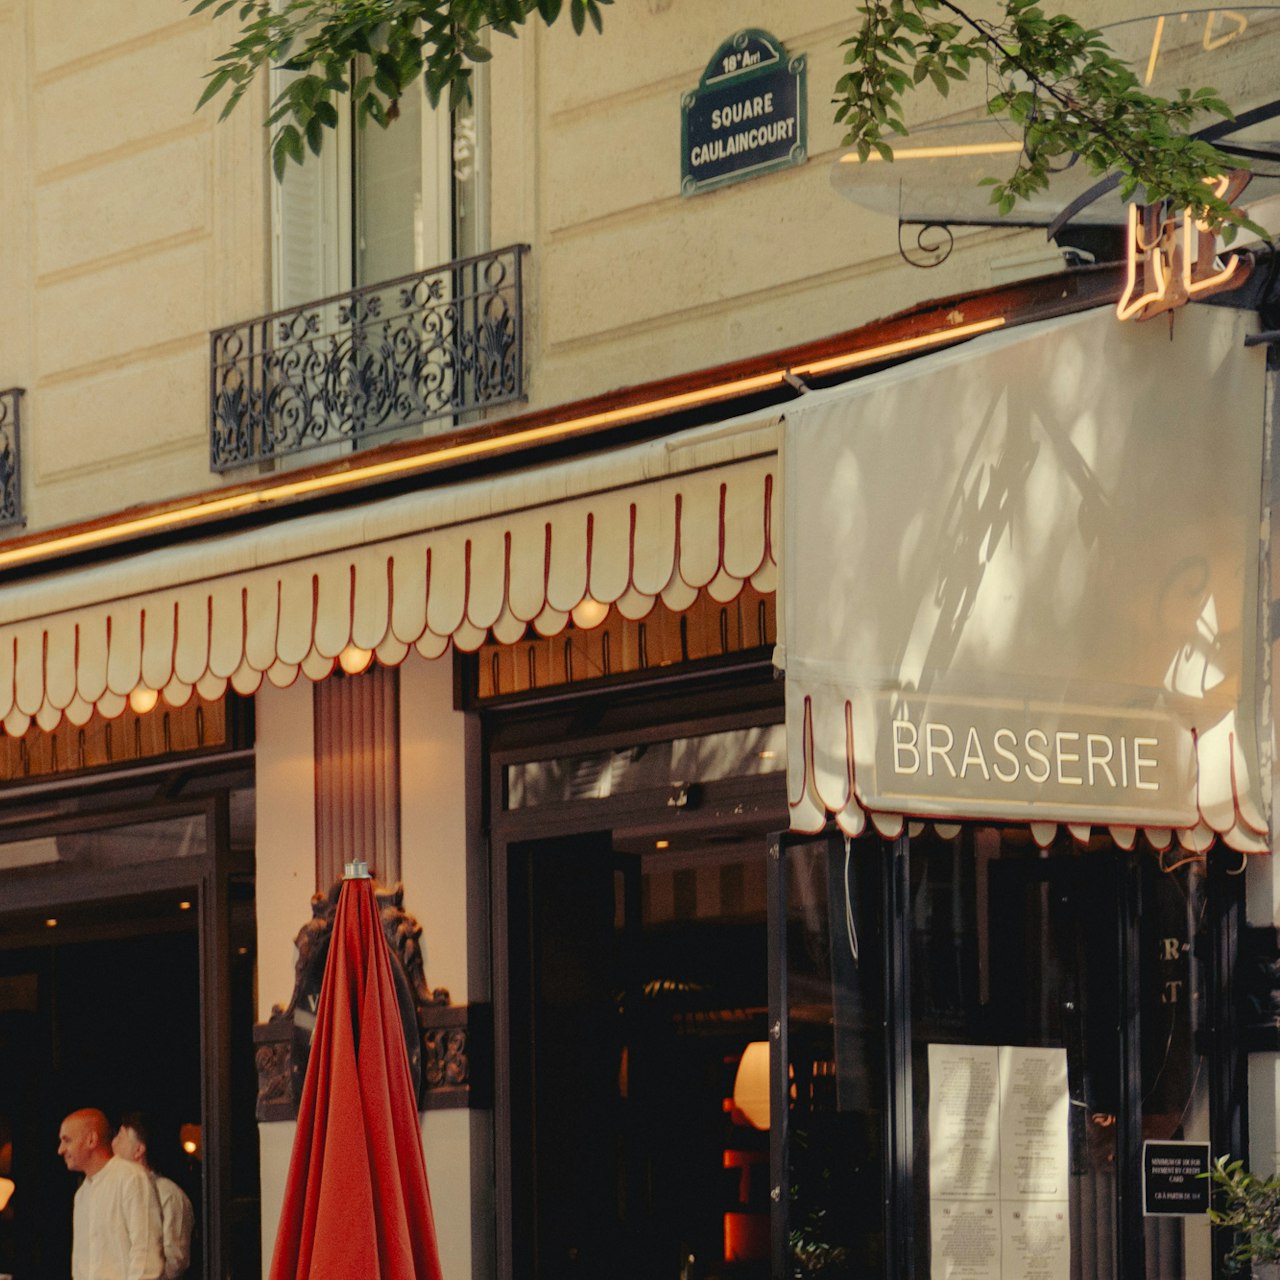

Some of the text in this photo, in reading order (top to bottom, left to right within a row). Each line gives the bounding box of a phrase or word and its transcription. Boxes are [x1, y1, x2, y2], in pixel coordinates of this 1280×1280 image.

[711, 92, 774, 130] SQUARE
[691, 117, 796, 167] CAULAINCOURT
[892, 719, 1160, 791] BRASSERIE
